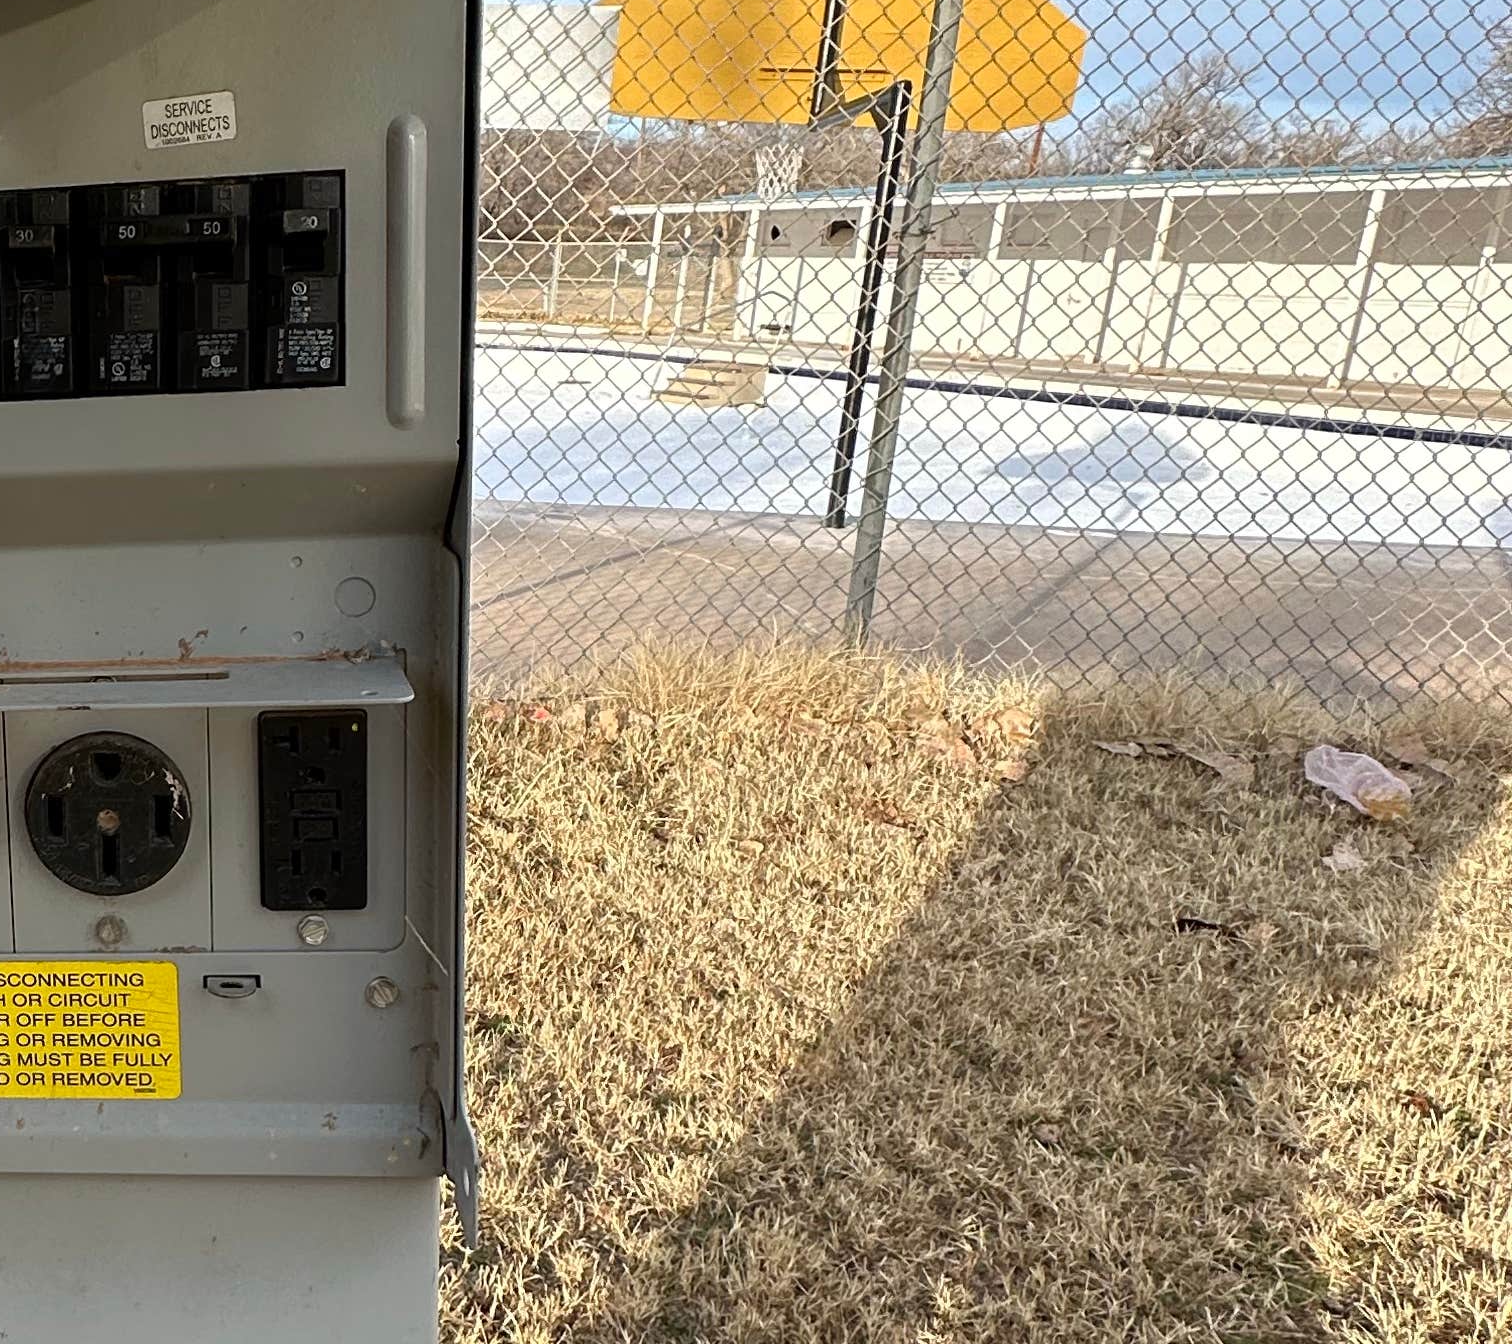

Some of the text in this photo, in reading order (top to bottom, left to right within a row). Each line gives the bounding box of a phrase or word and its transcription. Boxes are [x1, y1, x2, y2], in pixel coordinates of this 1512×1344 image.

[164, 98, 213, 119] SERVICE
[150, 115, 230, 140] DISCONNECTS
[202, 221, 221, 236] 50
[300, 215, 319, 229] 20
[14, 228, 34, 243] 30
[117, 225, 137, 240] 50
[12, 993, 42, 1007] OR
[48, 993, 131, 1007] CIRCUIT
[16, 1013, 56, 1027] OFF
[63, 1013, 145, 1027] BEFORE
[15, 1033, 45, 1047] OR
[52, 1033, 161, 1047] REMOVING
[17, 1052, 73, 1067] MUST
[80, 1052, 106, 1067] BE
[113, 1052, 172, 1067] FULLY
[16, 1072, 45, 1087] OR
